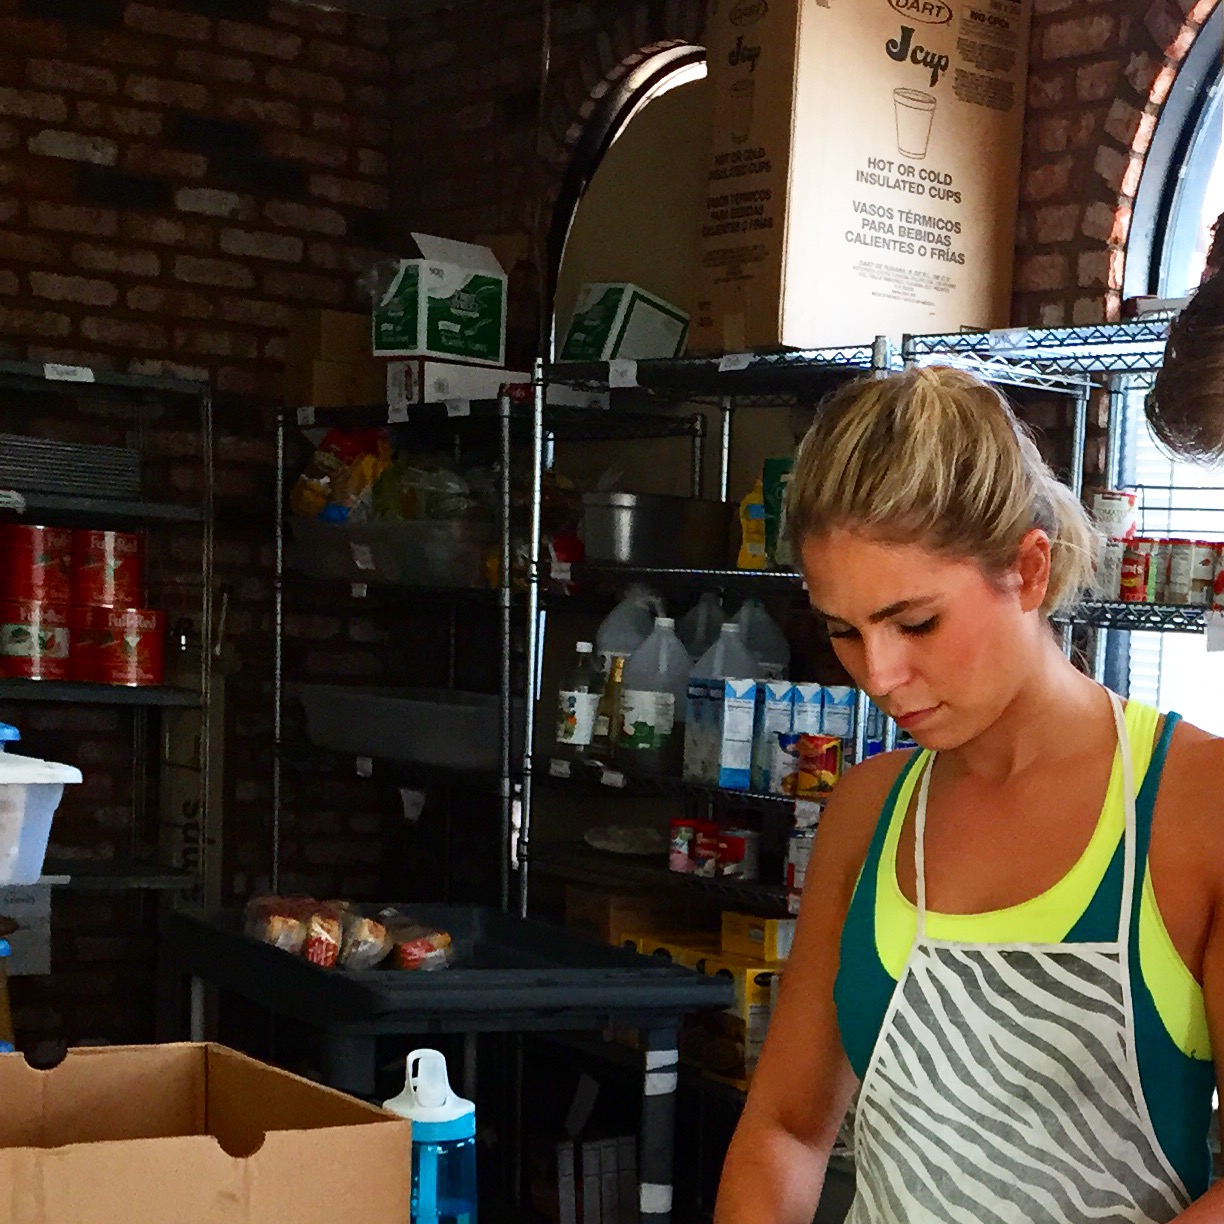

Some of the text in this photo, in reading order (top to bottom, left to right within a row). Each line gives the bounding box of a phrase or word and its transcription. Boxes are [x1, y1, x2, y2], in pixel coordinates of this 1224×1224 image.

[895, 0, 945, 17] DART
[856, 170, 962, 204] INSULATED CUPS
[867, 157, 953, 186] HOT OR COLD
[852, 200, 962, 235] VASOS TÉRMICOS
[861, 218, 952, 247] PARA BEBIDAS
[844, 230, 966, 265] CALIENTES O FRÍAS
